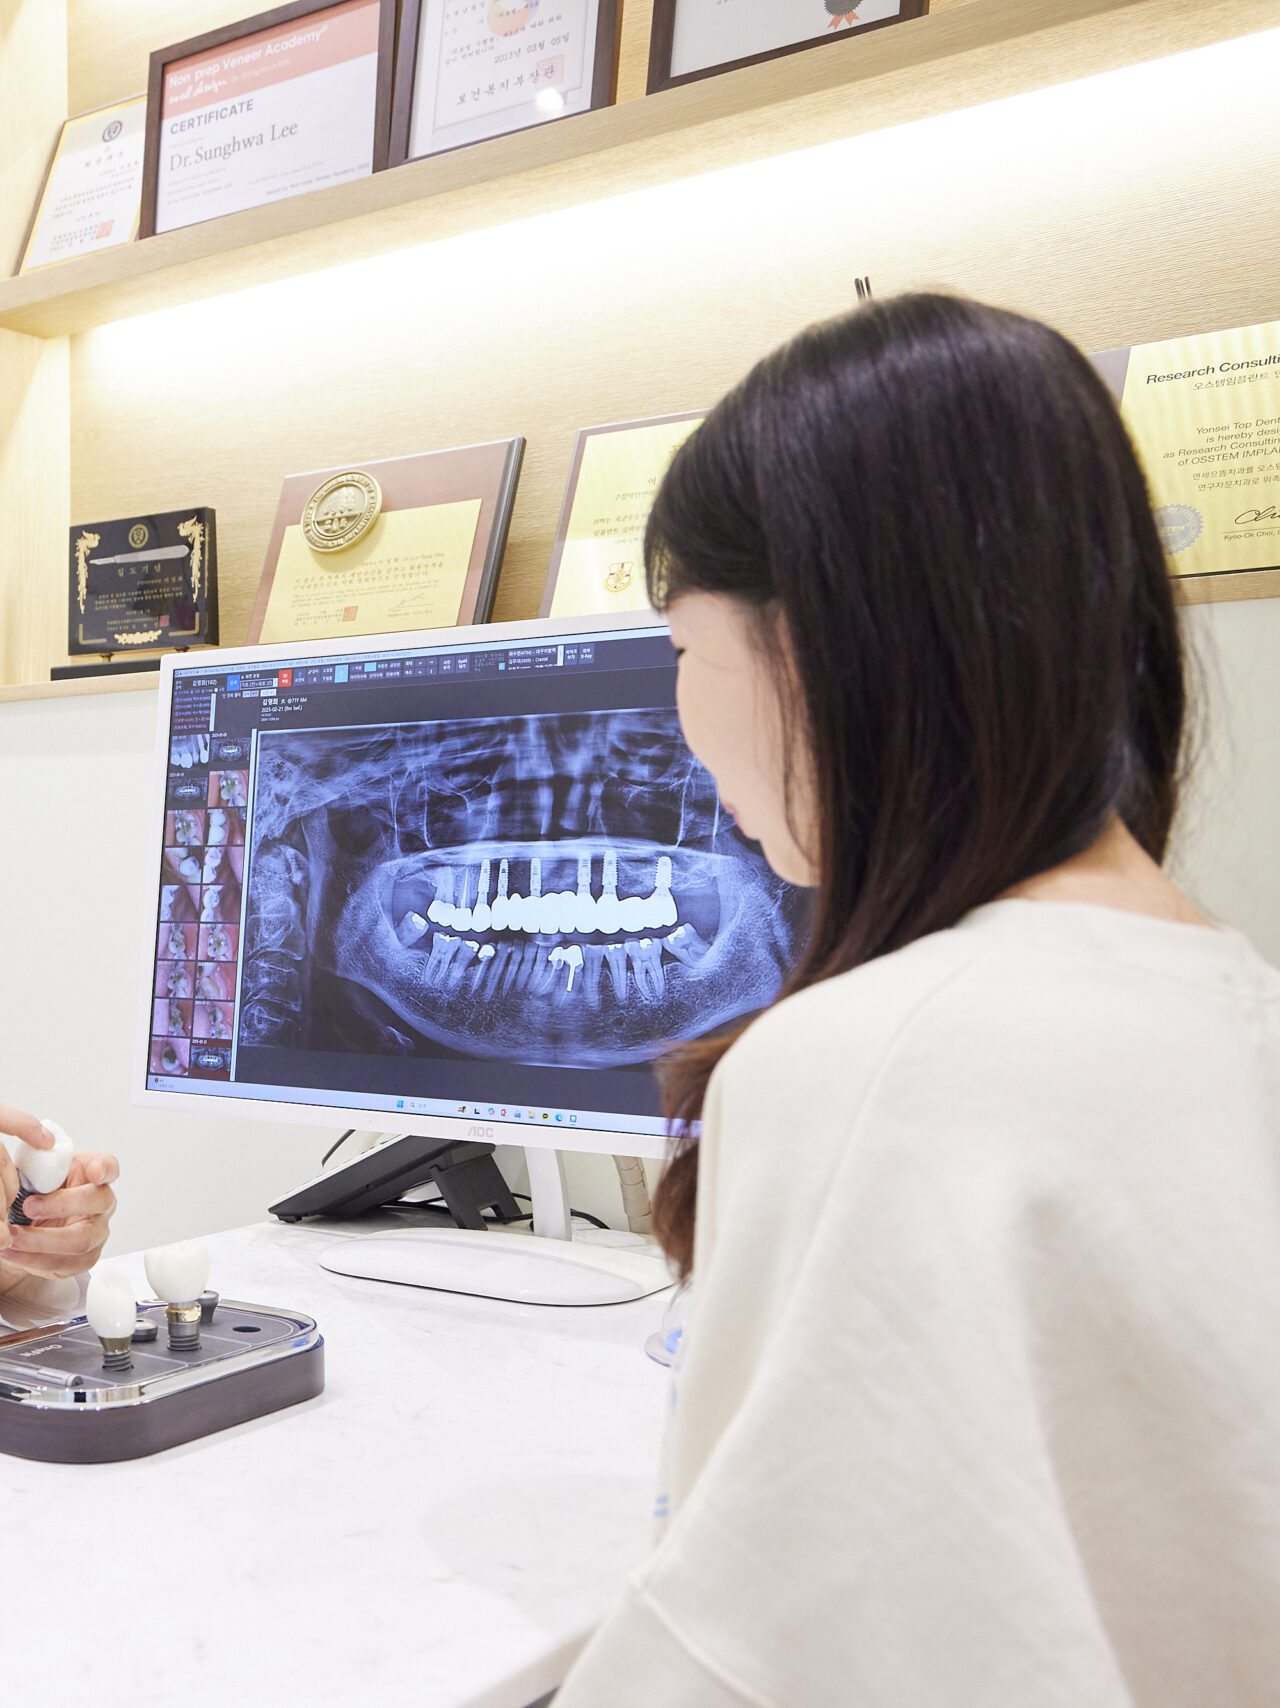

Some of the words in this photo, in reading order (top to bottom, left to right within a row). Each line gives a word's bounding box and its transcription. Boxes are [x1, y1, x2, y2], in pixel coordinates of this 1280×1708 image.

[494, 48, 521, 64] 2013년
[526, 40, 545, 54] 03월
[550, 32, 570, 46] 05일
[168, 73, 191, 88] Non
[194, 64, 220, 81] prep
[222, 49, 263, 70] Veneer
[170, 99, 254, 135] CERTIFICATE
[194, 132, 265, 165] Sunghwa
[270, 121, 299, 143] Lee
[1146, 365, 1215, 385] Research
[1193, 371, 1269, 391] 오스템임플란트
[1196, 424, 1230, 435] Yonsei
[1233, 421, 1252, 430] Top
[1217, 431, 1254, 443] hereby
[1178, 444, 1227, 456] Research
[1178, 459, 1188, 467] of
[1191, 452, 1239, 465] OSSTEM
[467, 1125, 494, 1138] AOC
